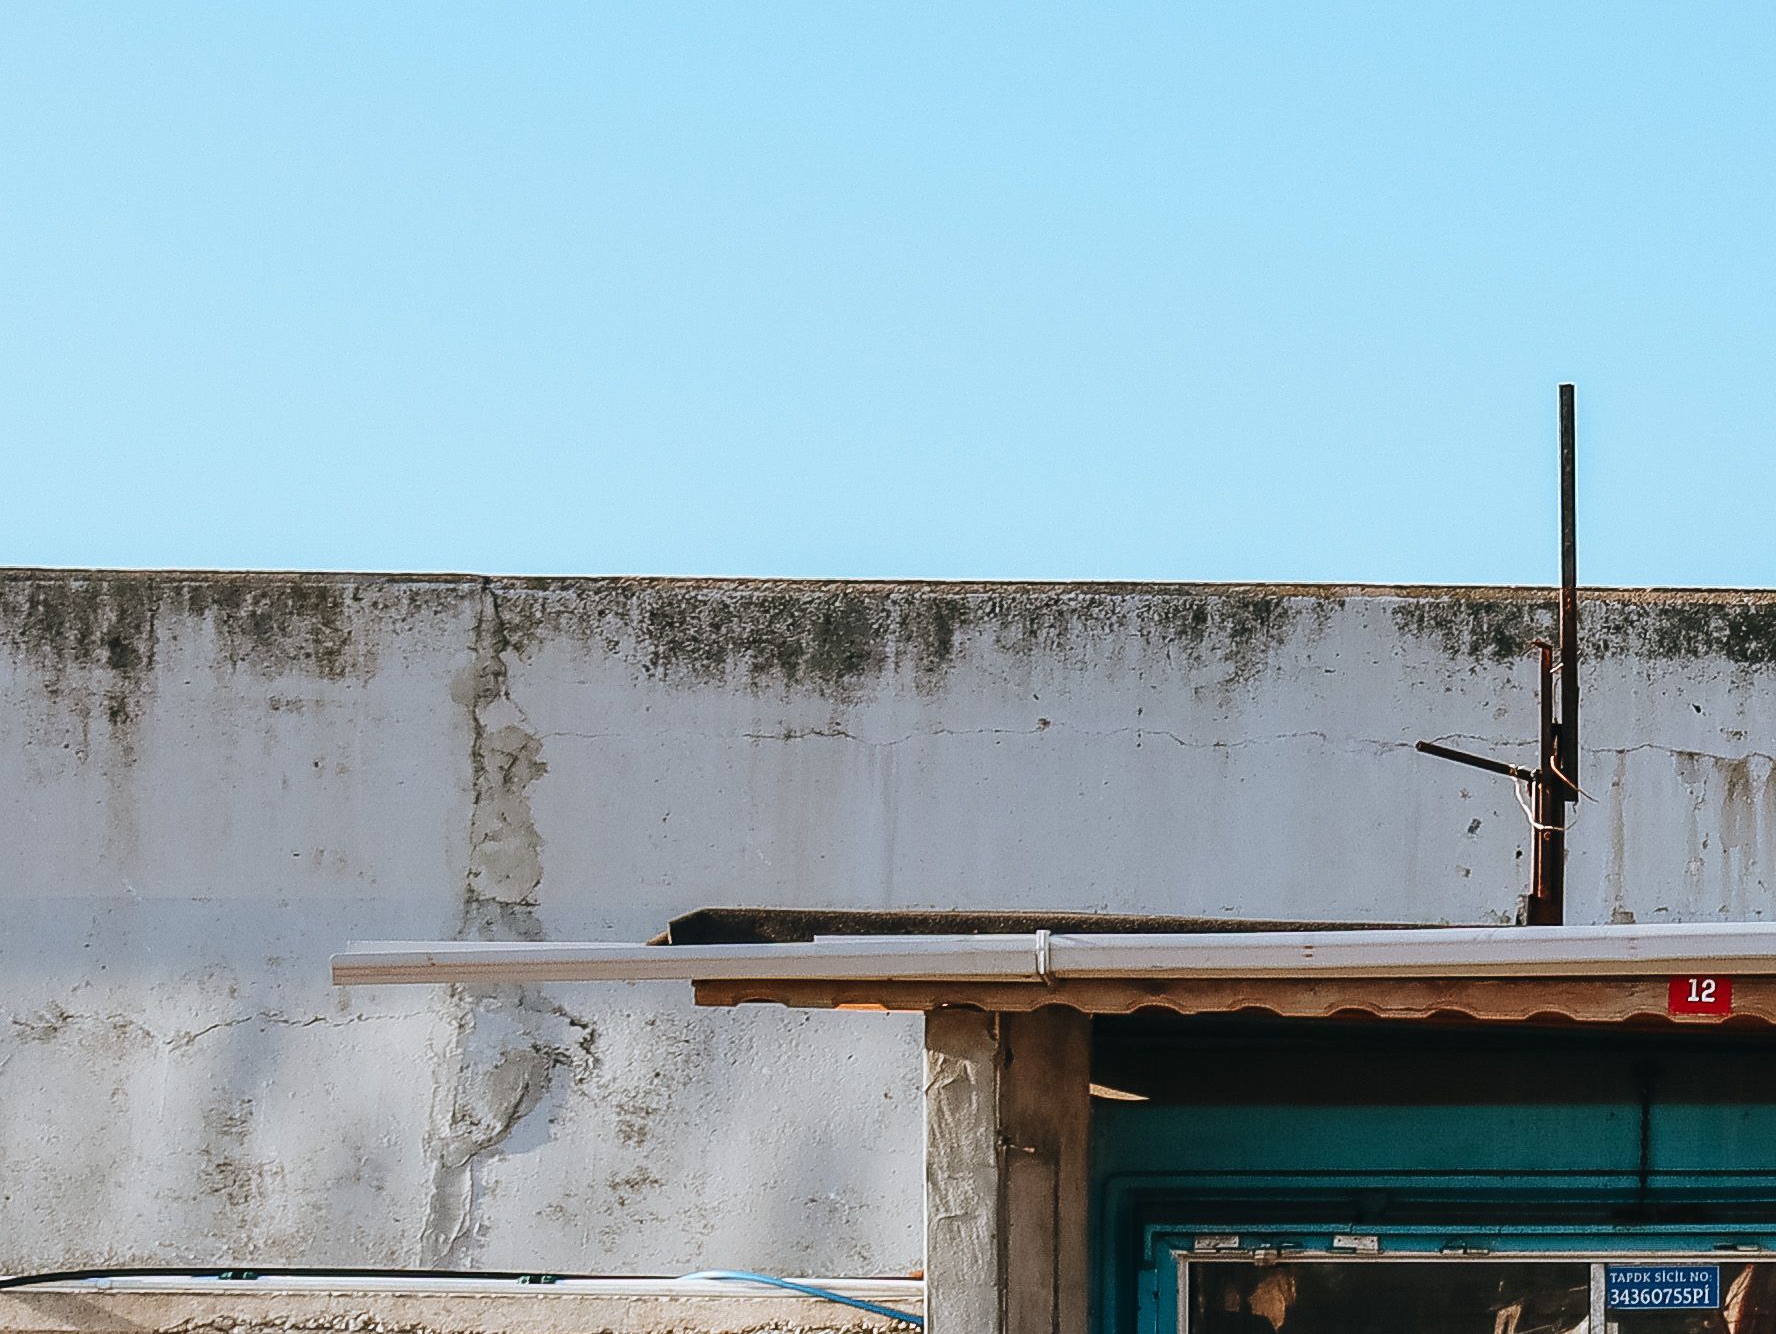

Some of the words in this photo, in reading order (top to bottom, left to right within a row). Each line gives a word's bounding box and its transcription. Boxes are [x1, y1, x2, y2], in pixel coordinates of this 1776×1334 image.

[1687, 979, 1716, 1002] 12
[1610, 1272, 1651, 1283] TAPDK
[1655, 1270, 1687, 1283] SİCİL
[1690, 1271, 1713, 1283] NO:
[1610, 1284, 1710, 1305] 34360755Pİ
